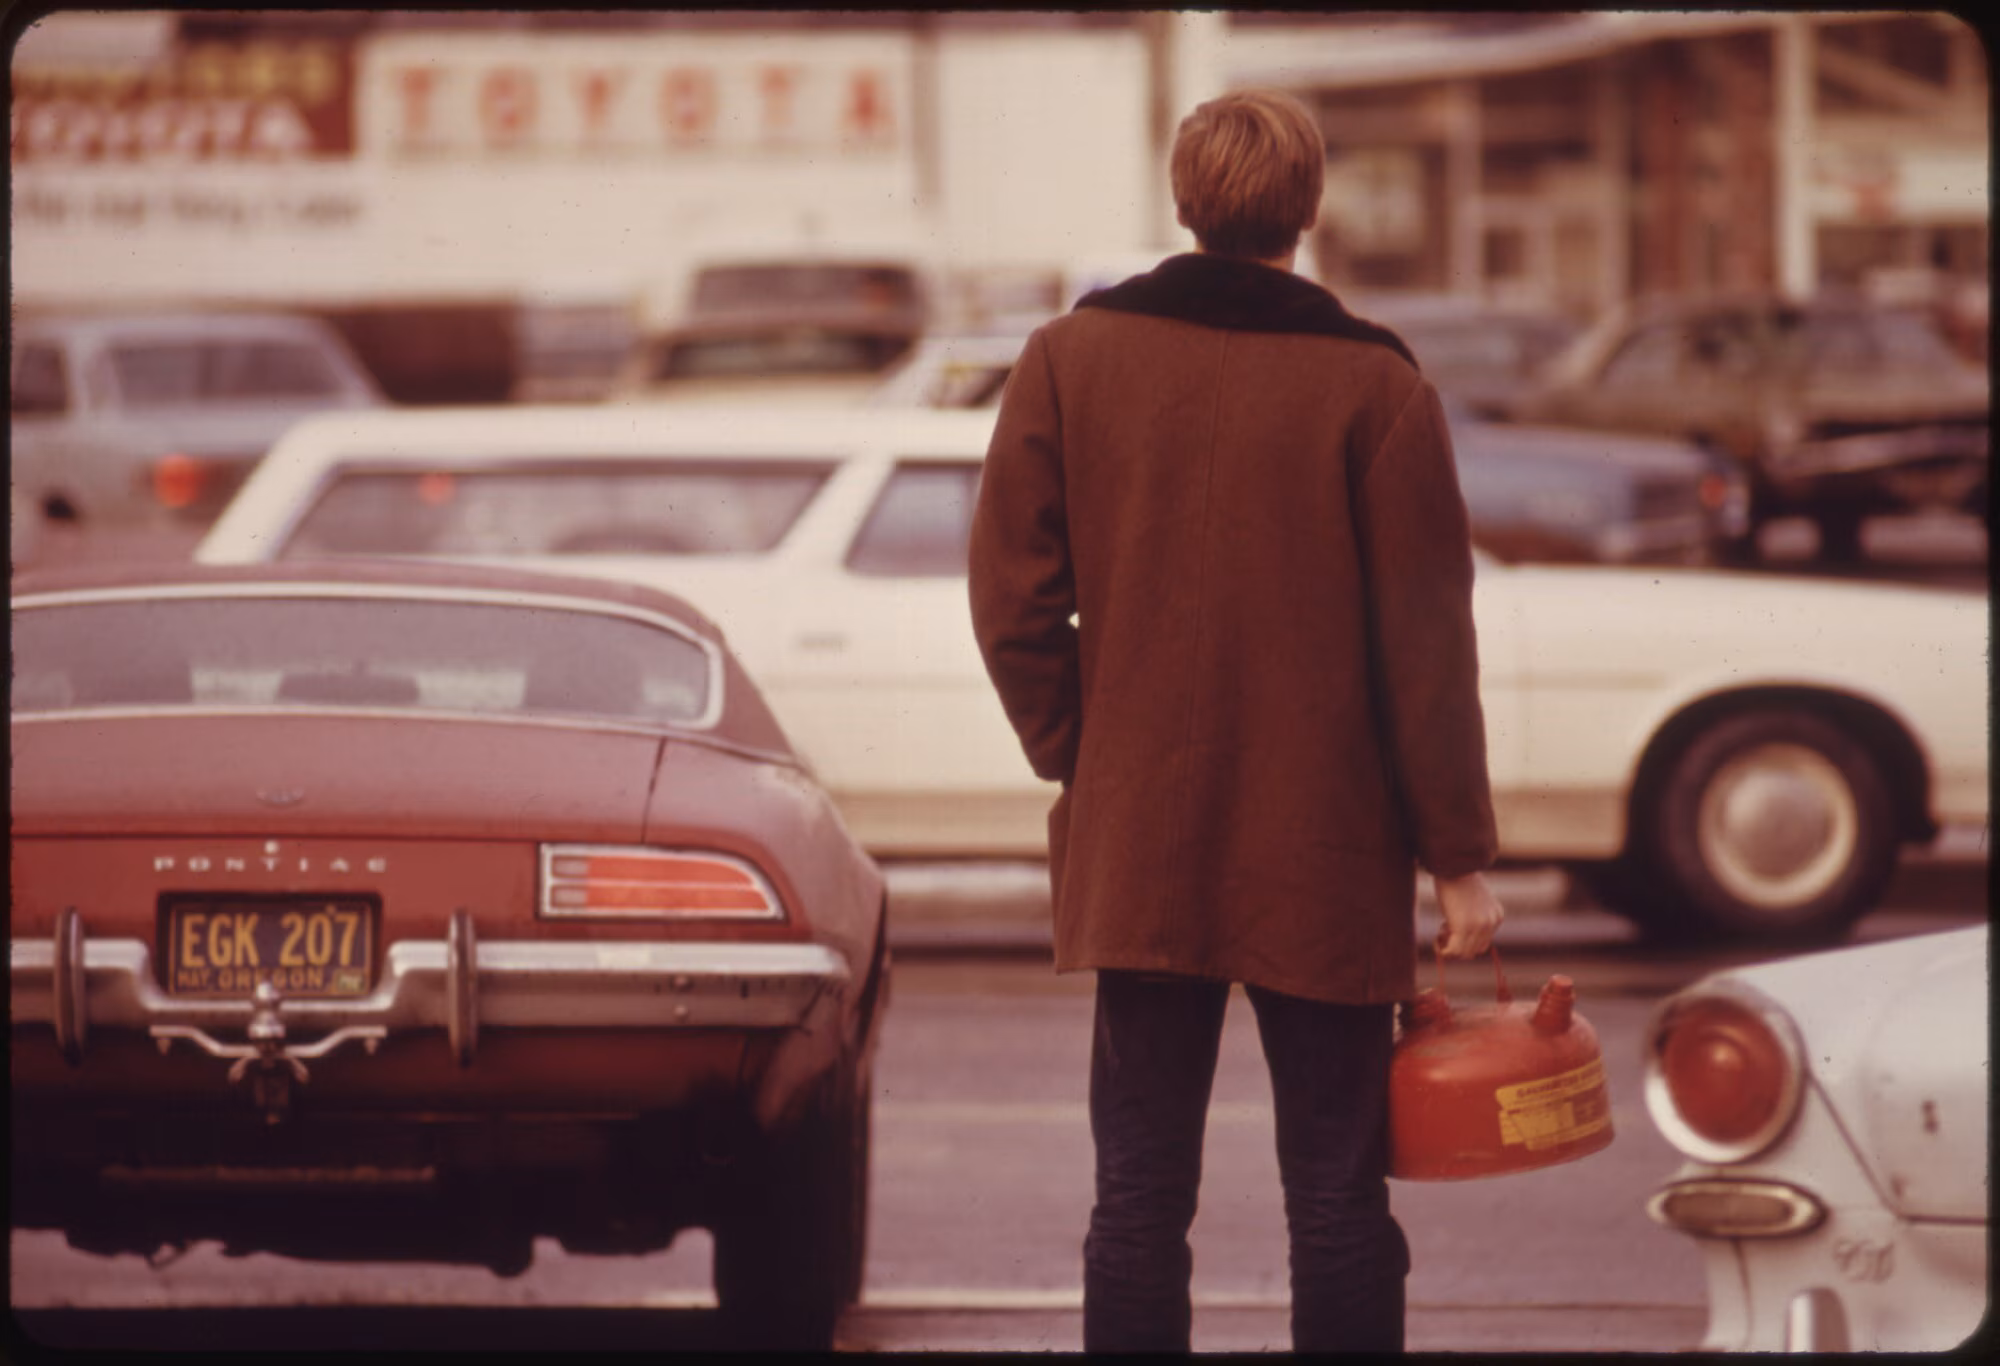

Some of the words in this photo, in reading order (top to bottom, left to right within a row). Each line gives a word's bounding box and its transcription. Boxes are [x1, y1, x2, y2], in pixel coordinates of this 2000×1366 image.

[393, 66, 893, 147] TOYOTA
[154, 856, 387, 873] PONTIAC
[181, 913, 260, 968] EGK
[278, 911, 360, 968] 207
